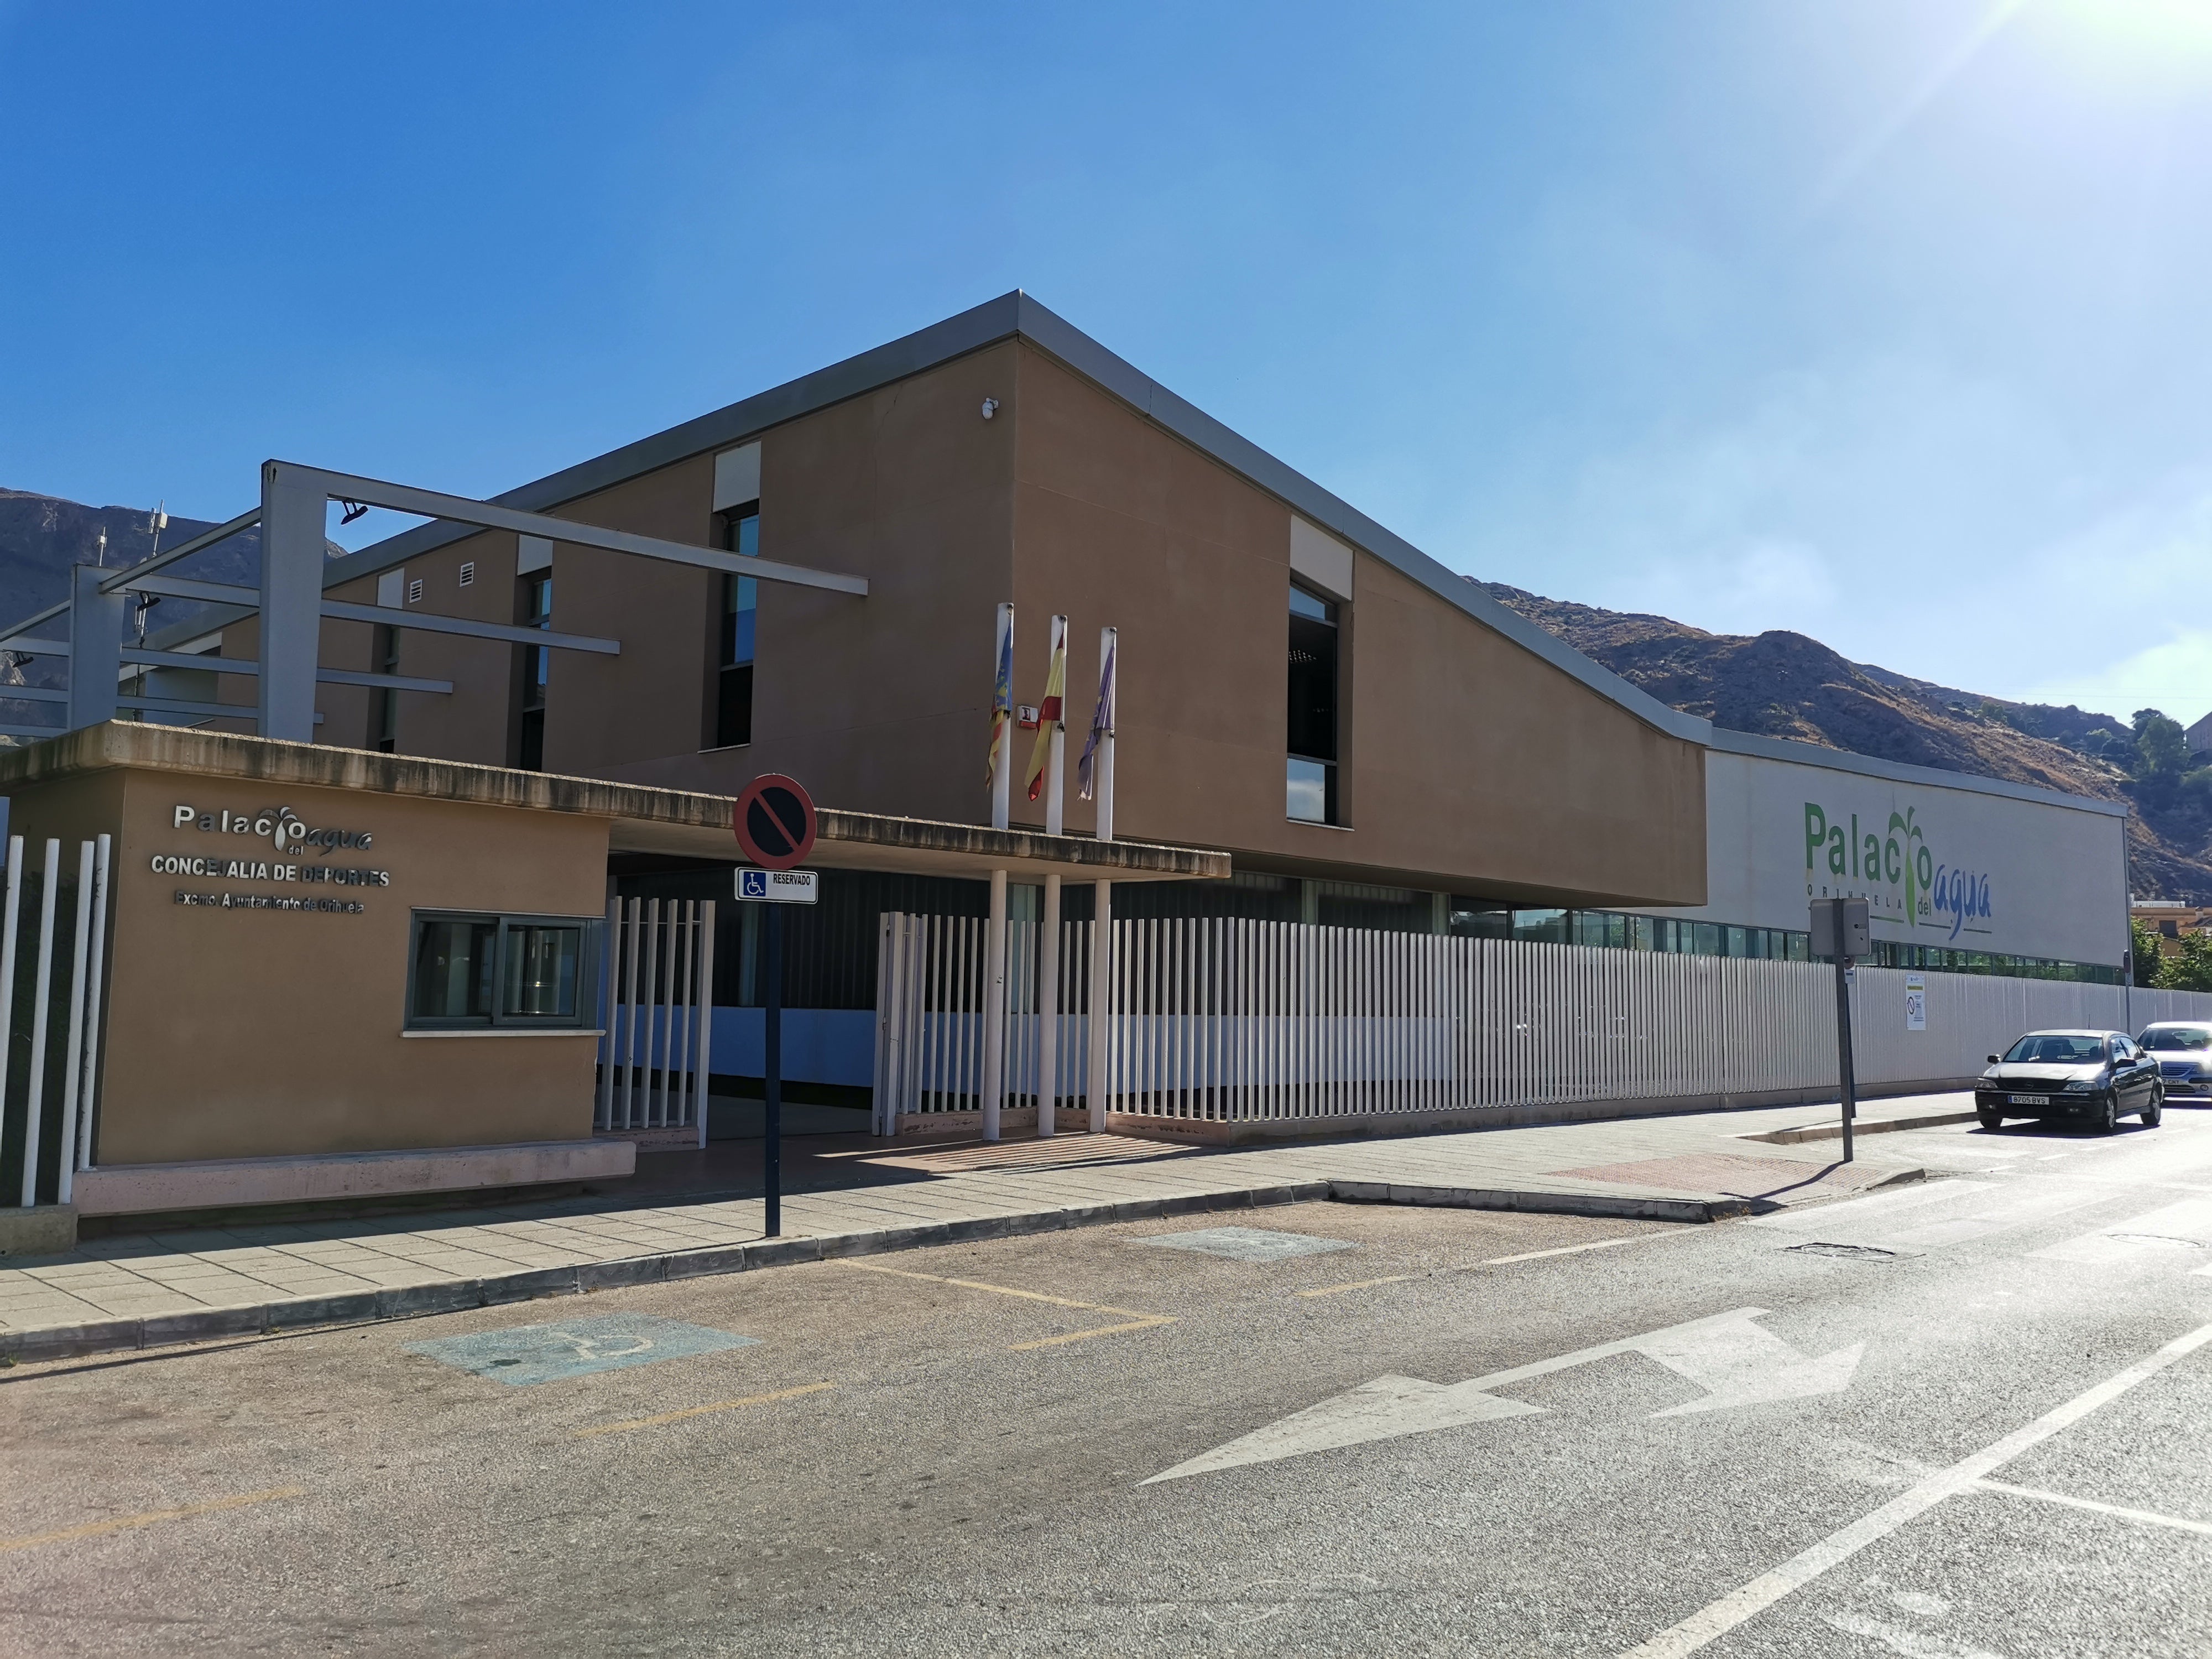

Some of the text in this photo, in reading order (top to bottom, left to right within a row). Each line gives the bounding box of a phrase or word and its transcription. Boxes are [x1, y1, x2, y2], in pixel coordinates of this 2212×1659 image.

[288, 844, 304, 855] del
[305, 828, 373, 857] agua
[151, 855, 390, 886] CONCEJALIA DE DEPORTES
[773, 873, 810, 885] RESERVADO
[221, 893, 300, 911] Ayuntamiento
[304, 897, 317, 911] de
[320, 899, 364, 914] Orihuela
[1917, 896, 1932, 916] del
[1933, 864, 1991, 940] agua
